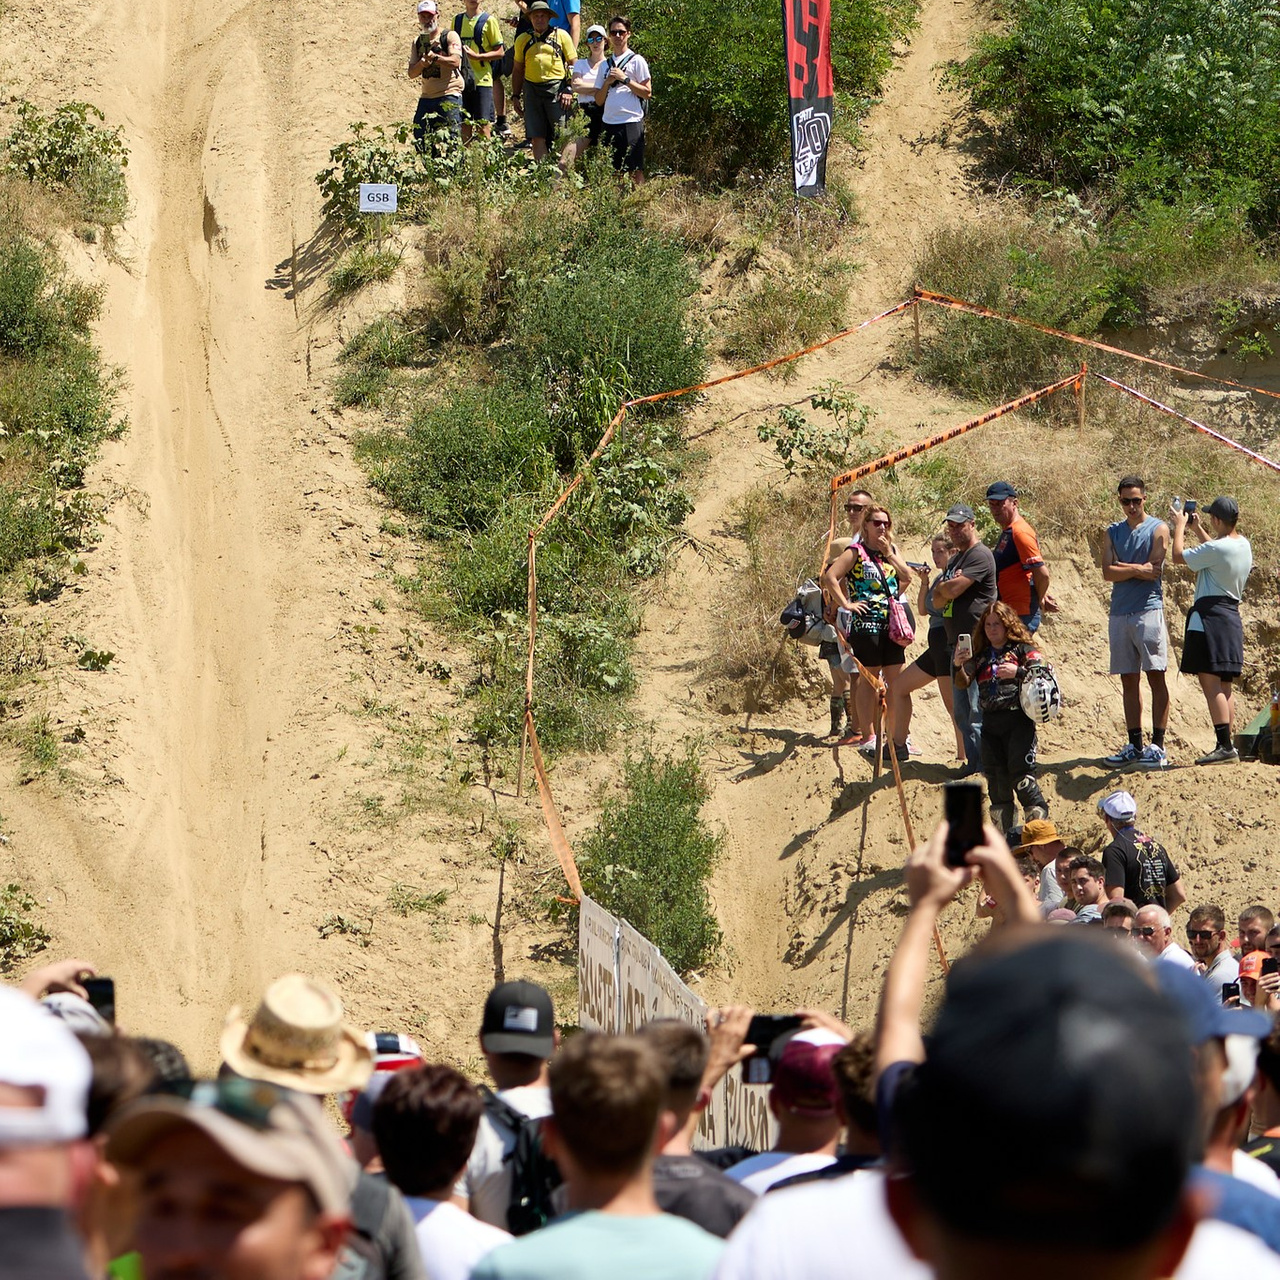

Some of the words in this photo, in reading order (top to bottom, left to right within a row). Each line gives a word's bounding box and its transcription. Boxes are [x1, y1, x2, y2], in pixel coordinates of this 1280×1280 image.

[367, 192, 390, 203] GSB
[837, 474, 852, 487] KTM
[856, 467, 871, 479] KTM
[874, 459, 889, 471] KTM
[893, 451, 908, 463] KTM
[911, 443, 926, 455] KTM
